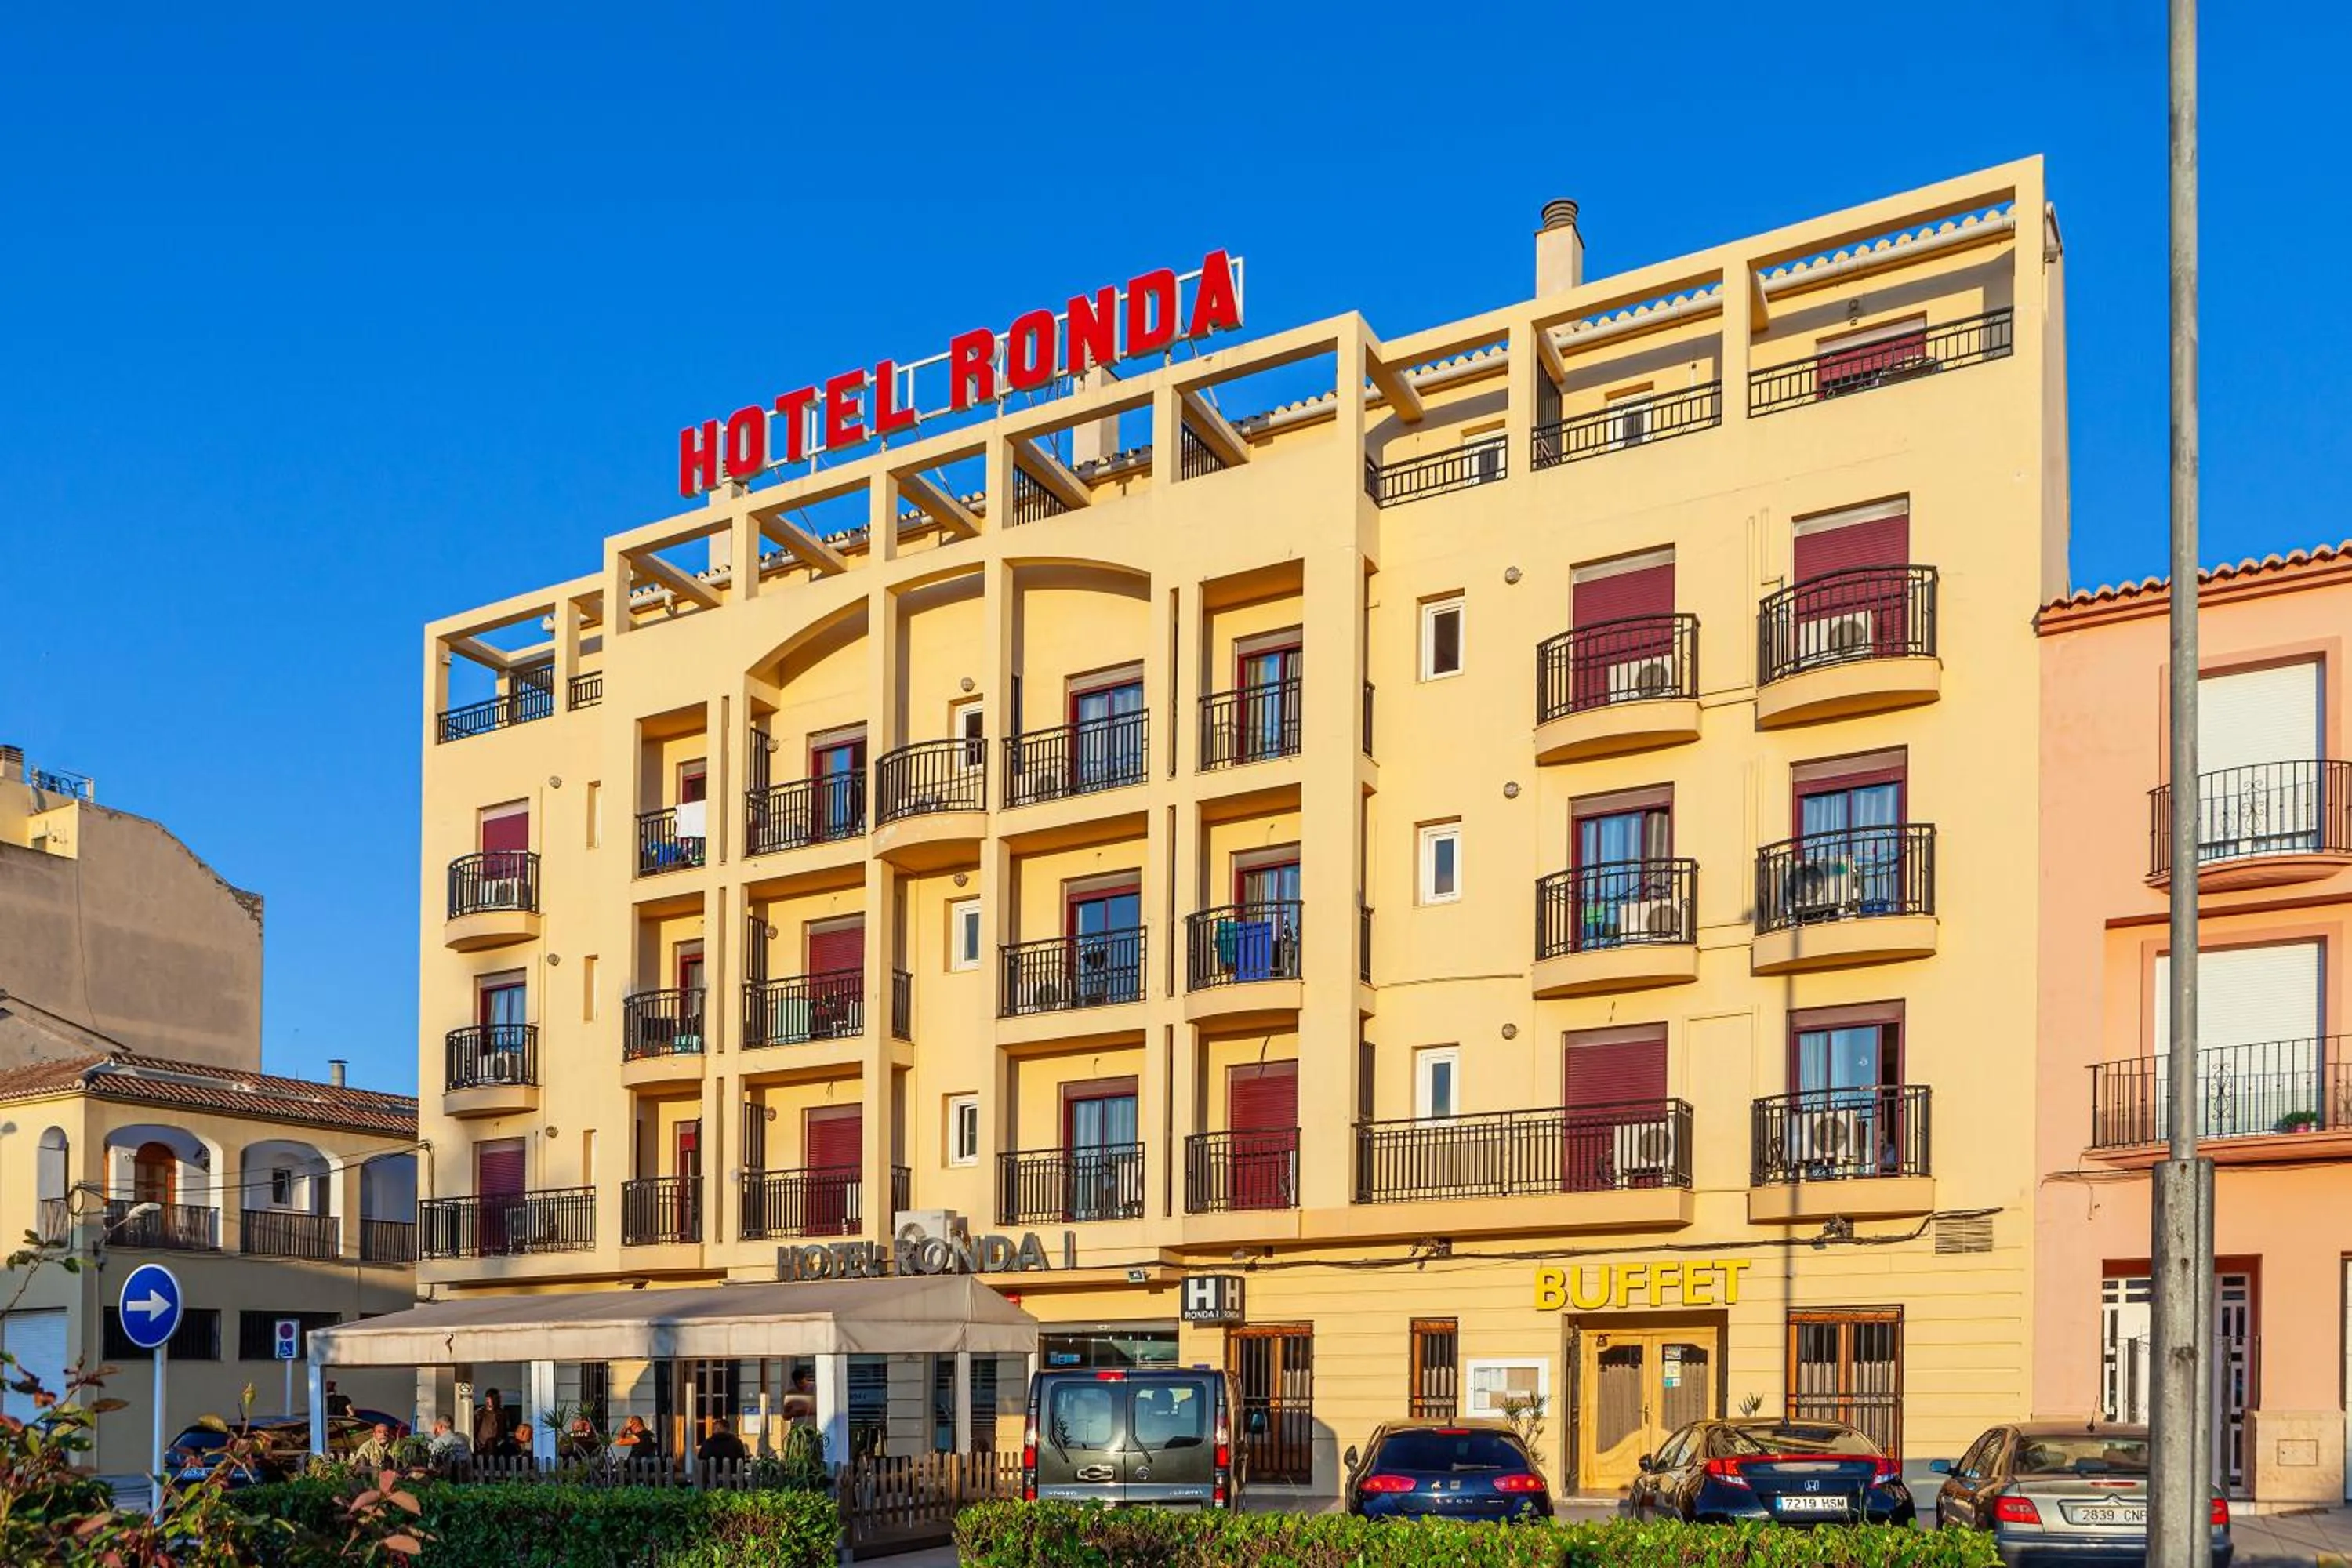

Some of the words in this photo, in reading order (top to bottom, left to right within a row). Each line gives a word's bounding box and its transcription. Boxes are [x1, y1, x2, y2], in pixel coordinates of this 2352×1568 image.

[679, 359, 920, 498] HOTEL
[949, 248, 1245, 412] RONDA
[777, 1240, 887, 1281] HOTEL
[894, 1232, 1051, 1276] RONDA
[1063, 1230, 1076, 1269] I
[1188, 1278, 1216, 1310] H
[1225, 1279, 1240, 1310] H
[1535, 1259, 1751, 1311] BUFFET
[1185, 1310, 1214, 1319] RONDA
[1785, 1498, 1817, 1509] 7219
[2082, 1509, 2115, 1521] 2839
